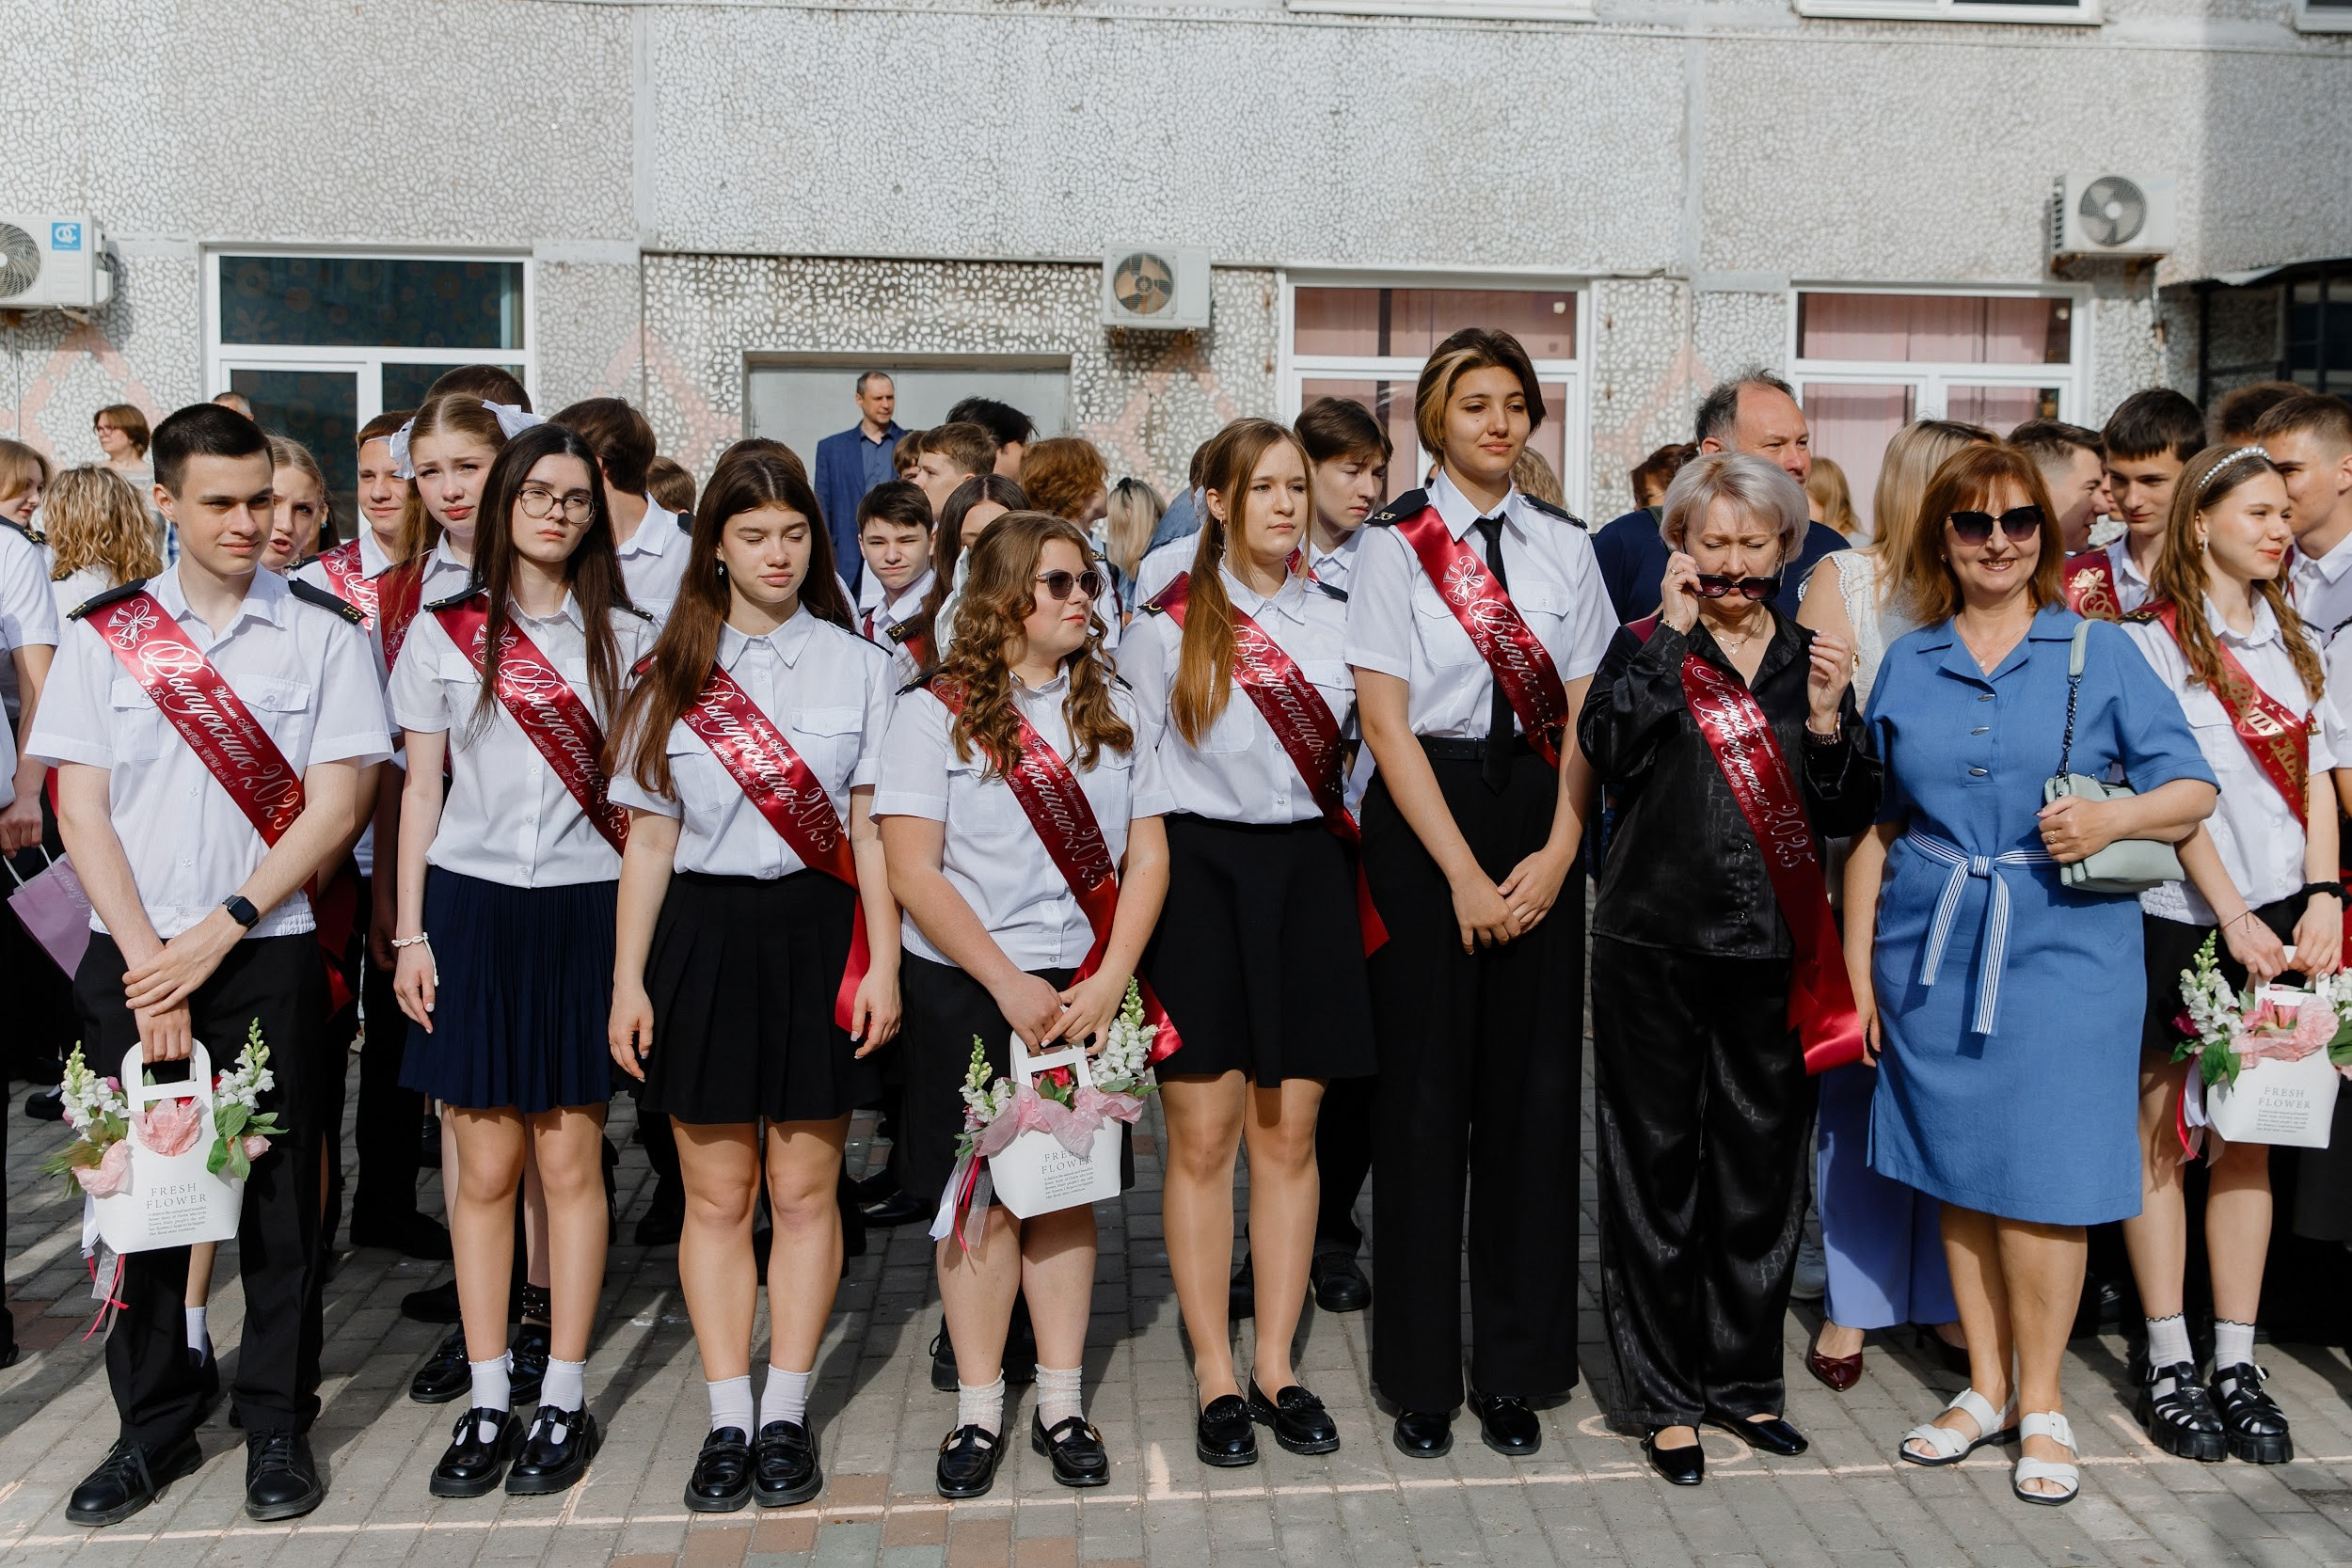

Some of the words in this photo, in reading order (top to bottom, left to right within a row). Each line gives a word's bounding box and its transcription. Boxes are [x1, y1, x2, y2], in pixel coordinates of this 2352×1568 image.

[1374, 511, 1396, 520] 33
[342, 605, 363, 620] 33
[1471, 629, 1484, 639] 9
[140, 673, 154, 686] 9
[499, 688, 512, 699] 9
[1232, 625, 1325, 751] Выпускница
[1692, 665, 1759, 738] Классный
[138, 640, 259, 769] Выпускник
[238, 763, 302, 831] 2025
[236, 718, 262, 749] Артём
[746, 713, 774, 741] Лосева
[769, 739, 794, 768] Арина
[696, 676, 796, 800] Выпускница
[783, 786, 846, 852] 2025
[224, 780, 236, 788] 33
[1029, 738, 1063, 781] Болдырева
[1060, 776, 1085, 818] Вероника
[1692, 698, 1770, 806] руководитель
[1762, 802, 1816, 869] 2025
[755, 797, 767, 806] 33
[1063, 826, 1116, 891] 2025
[2264, 1086, 2304, 1098] FRESH
[2258, 1097, 2311, 1109] FLOWER
[1044, 1150, 1080, 1162] FRES
[1041, 1156, 1093, 1174] FLOWER
[151, 1182, 197, 1196] FRESH
[146, 1193, 207, 1210] FLOWER
